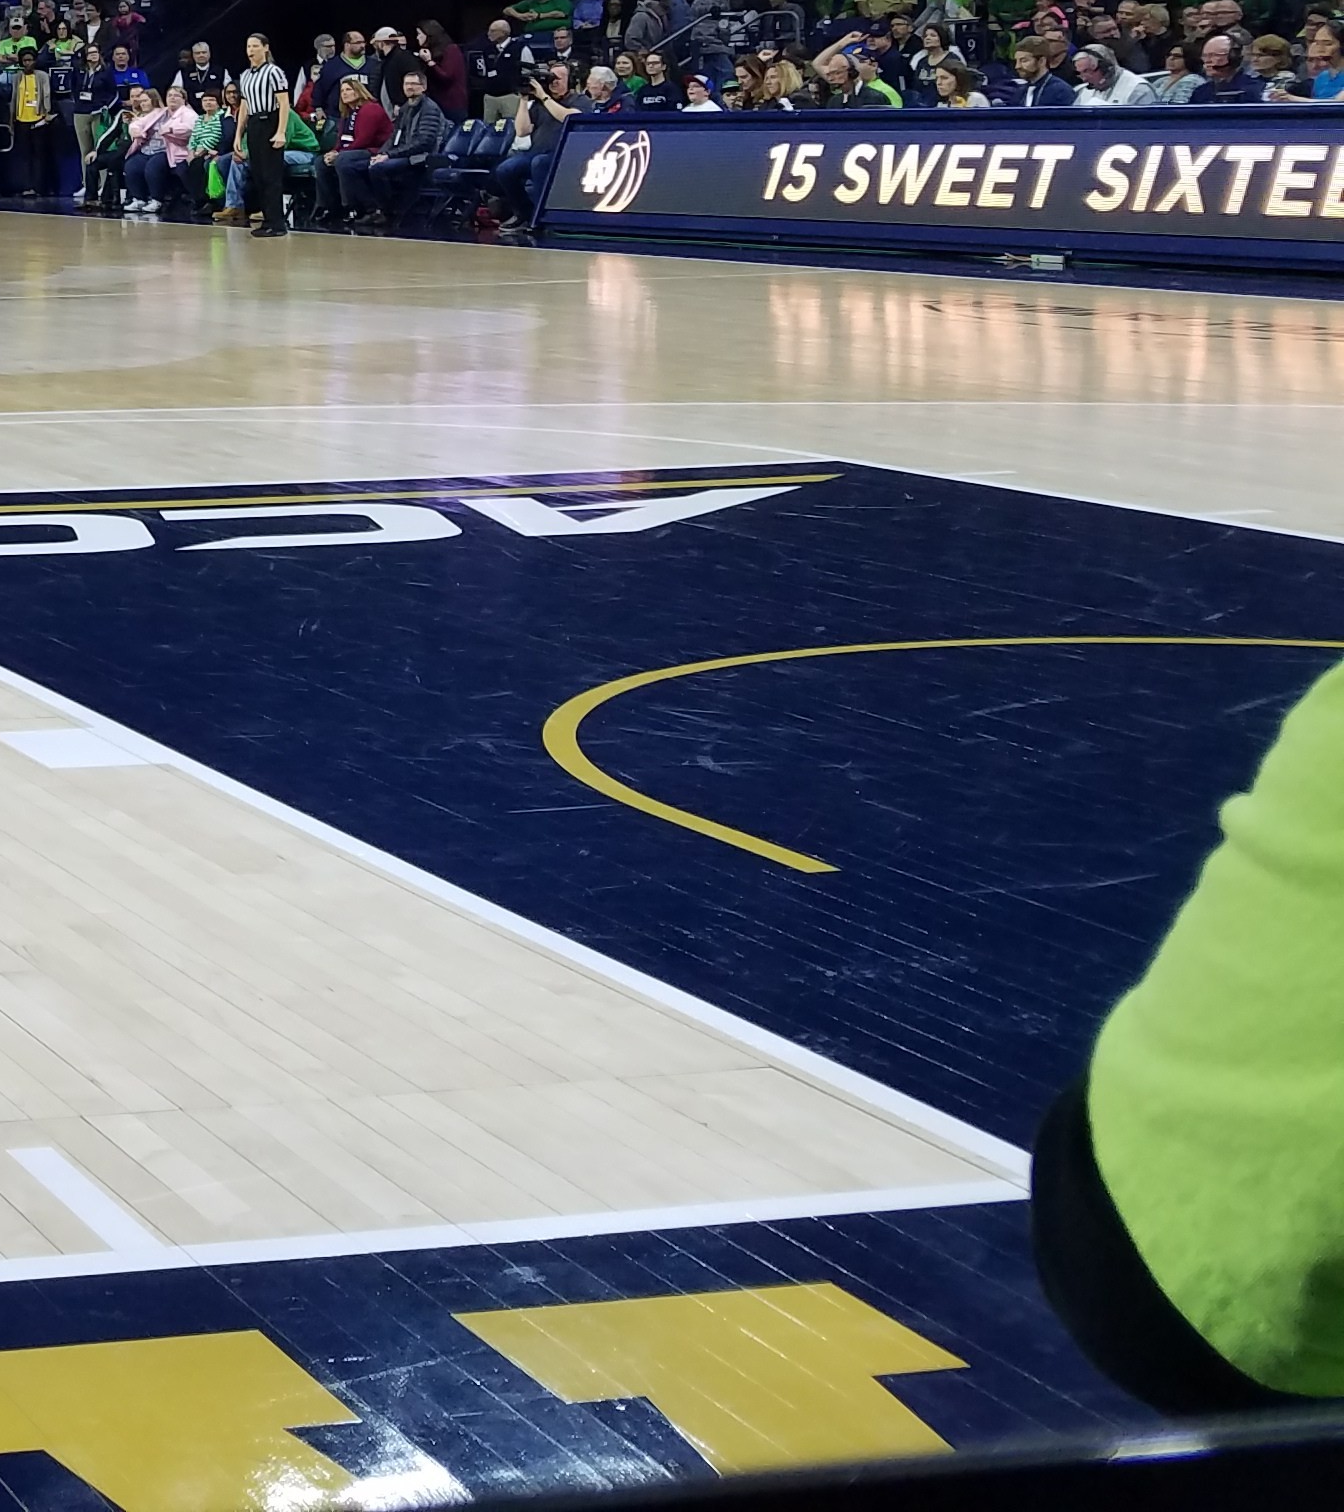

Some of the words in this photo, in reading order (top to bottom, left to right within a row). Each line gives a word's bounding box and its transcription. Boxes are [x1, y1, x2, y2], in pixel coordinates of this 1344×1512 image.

[967, 39, 976, 52] 9
[762, 143, 825, 203] 15
[833, 143, 1075, 209] SWEET
